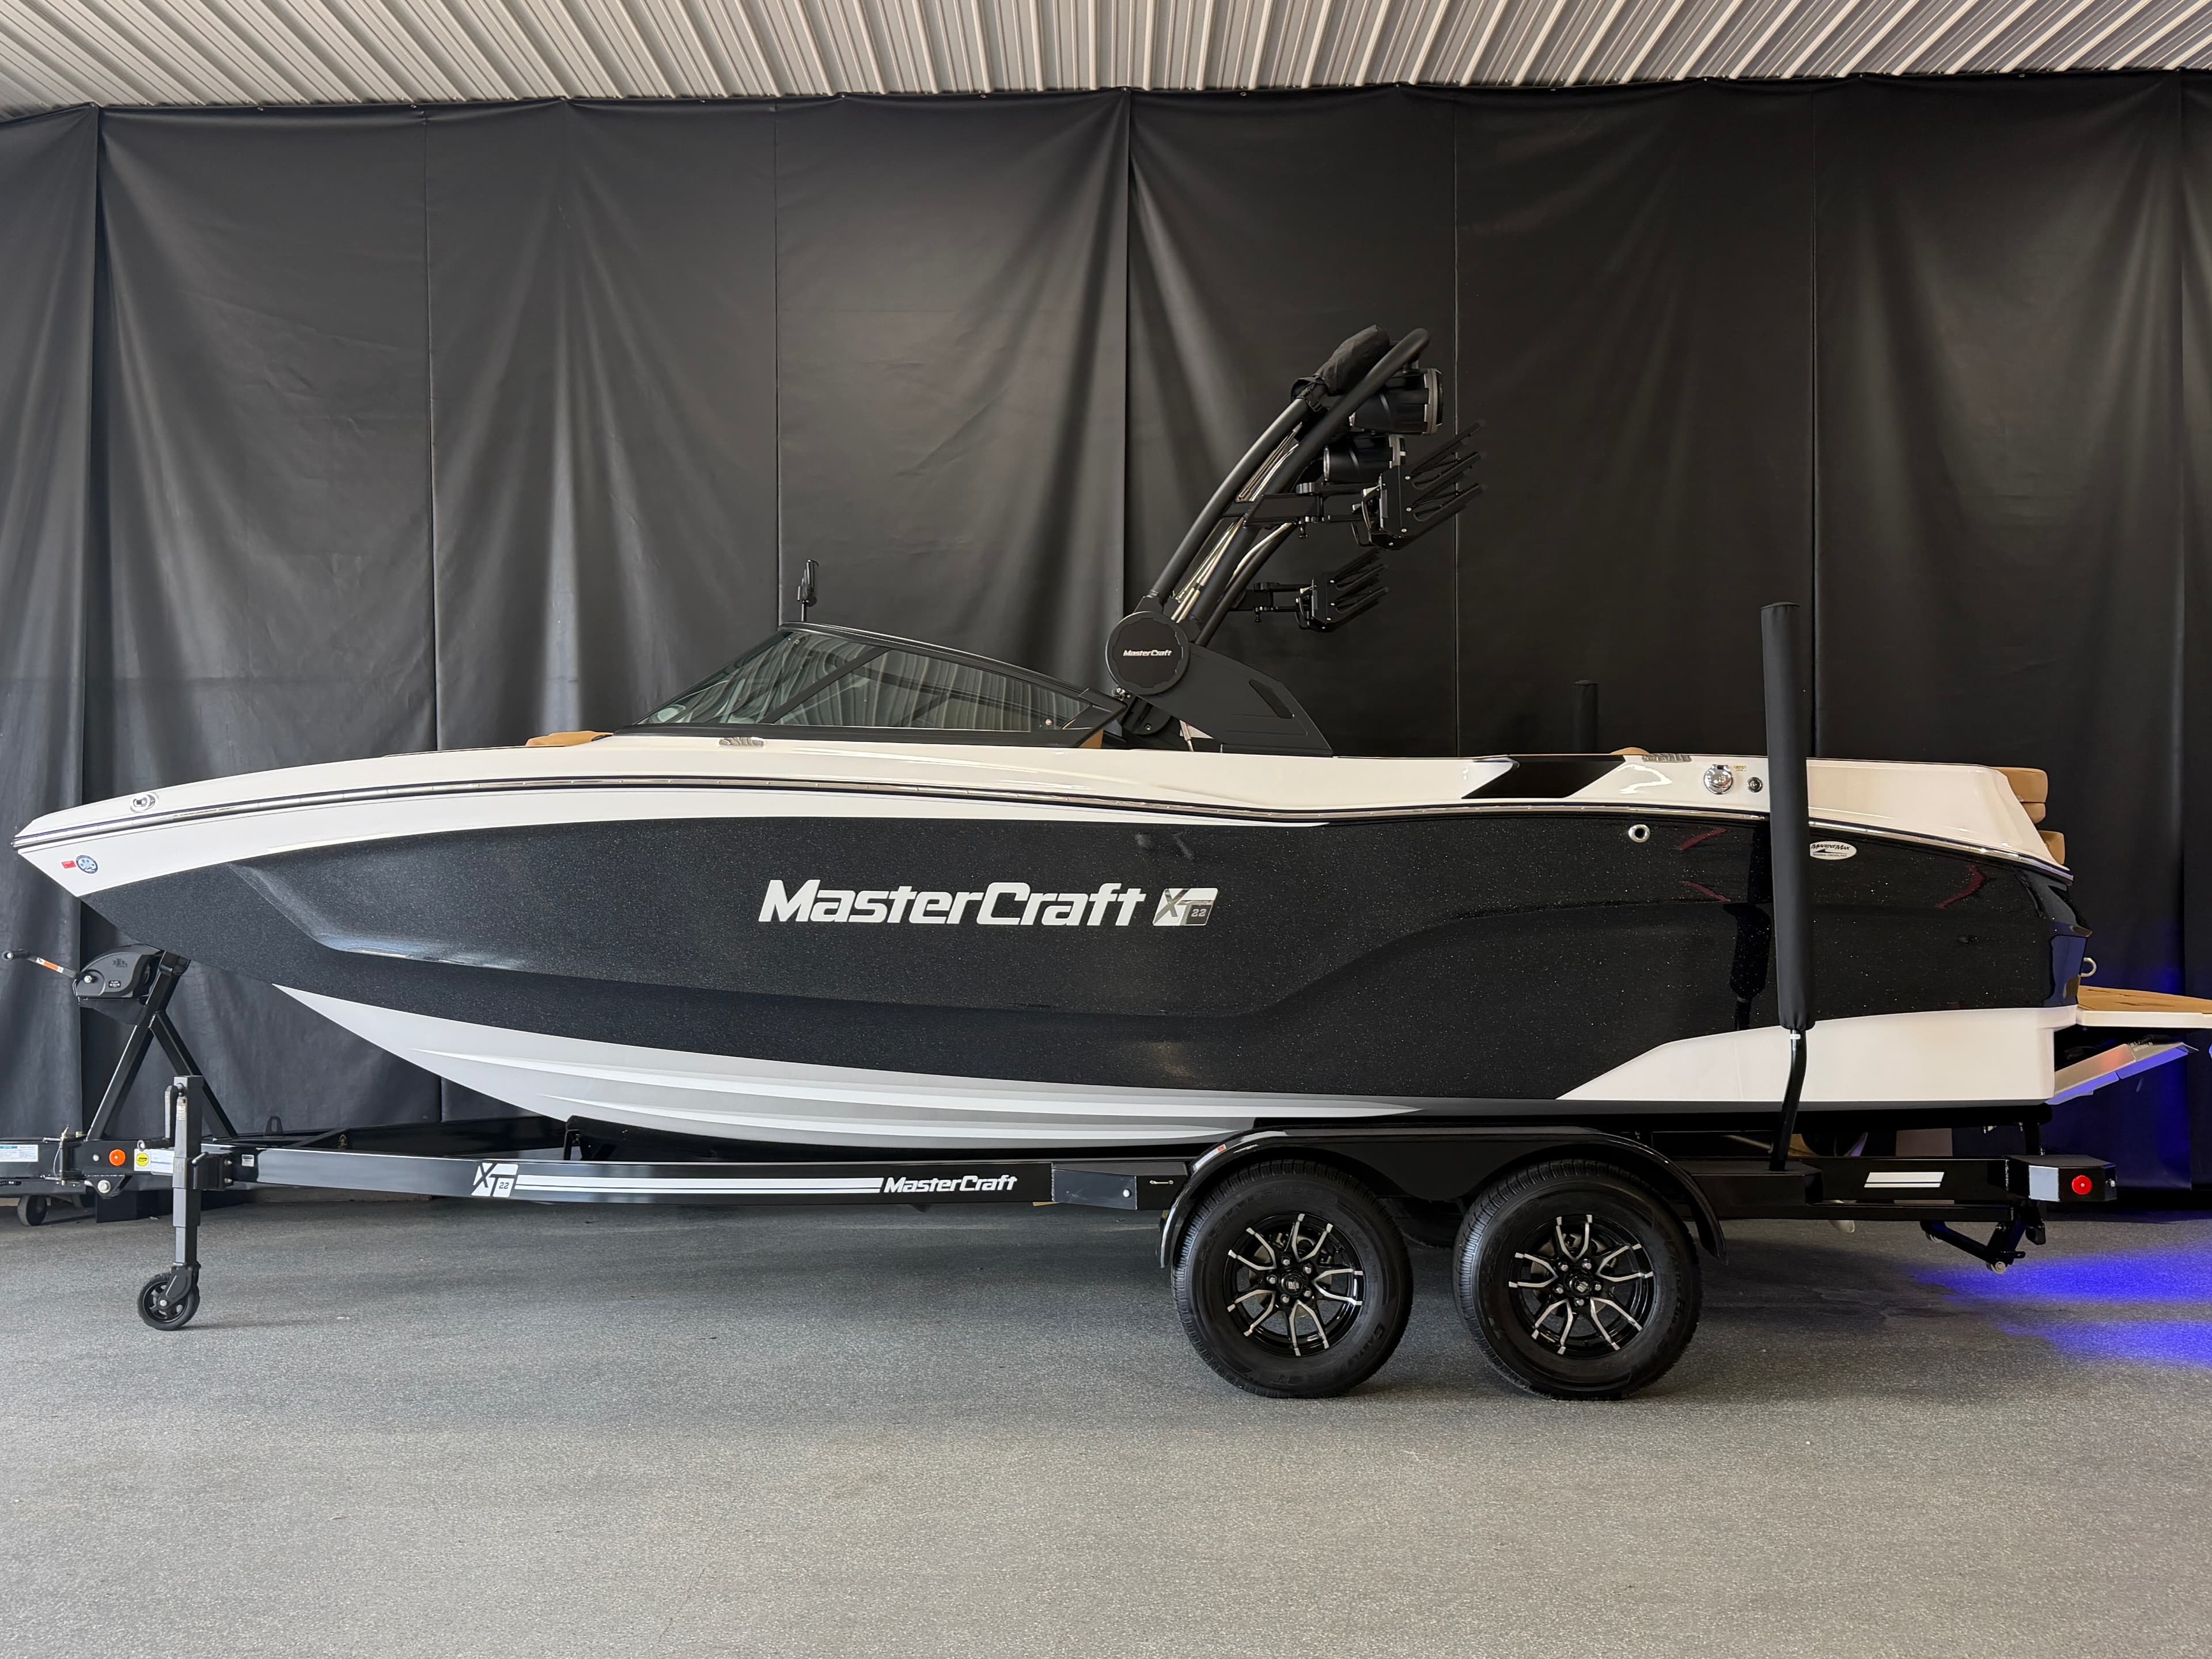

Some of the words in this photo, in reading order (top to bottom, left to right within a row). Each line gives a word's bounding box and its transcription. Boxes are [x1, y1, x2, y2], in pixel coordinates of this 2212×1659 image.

[758, 879, 1146, 926] MasterCraft
[1191, 908, 1207, 918] 22
[884, 1175, 1018, 1194] MasterCraft
